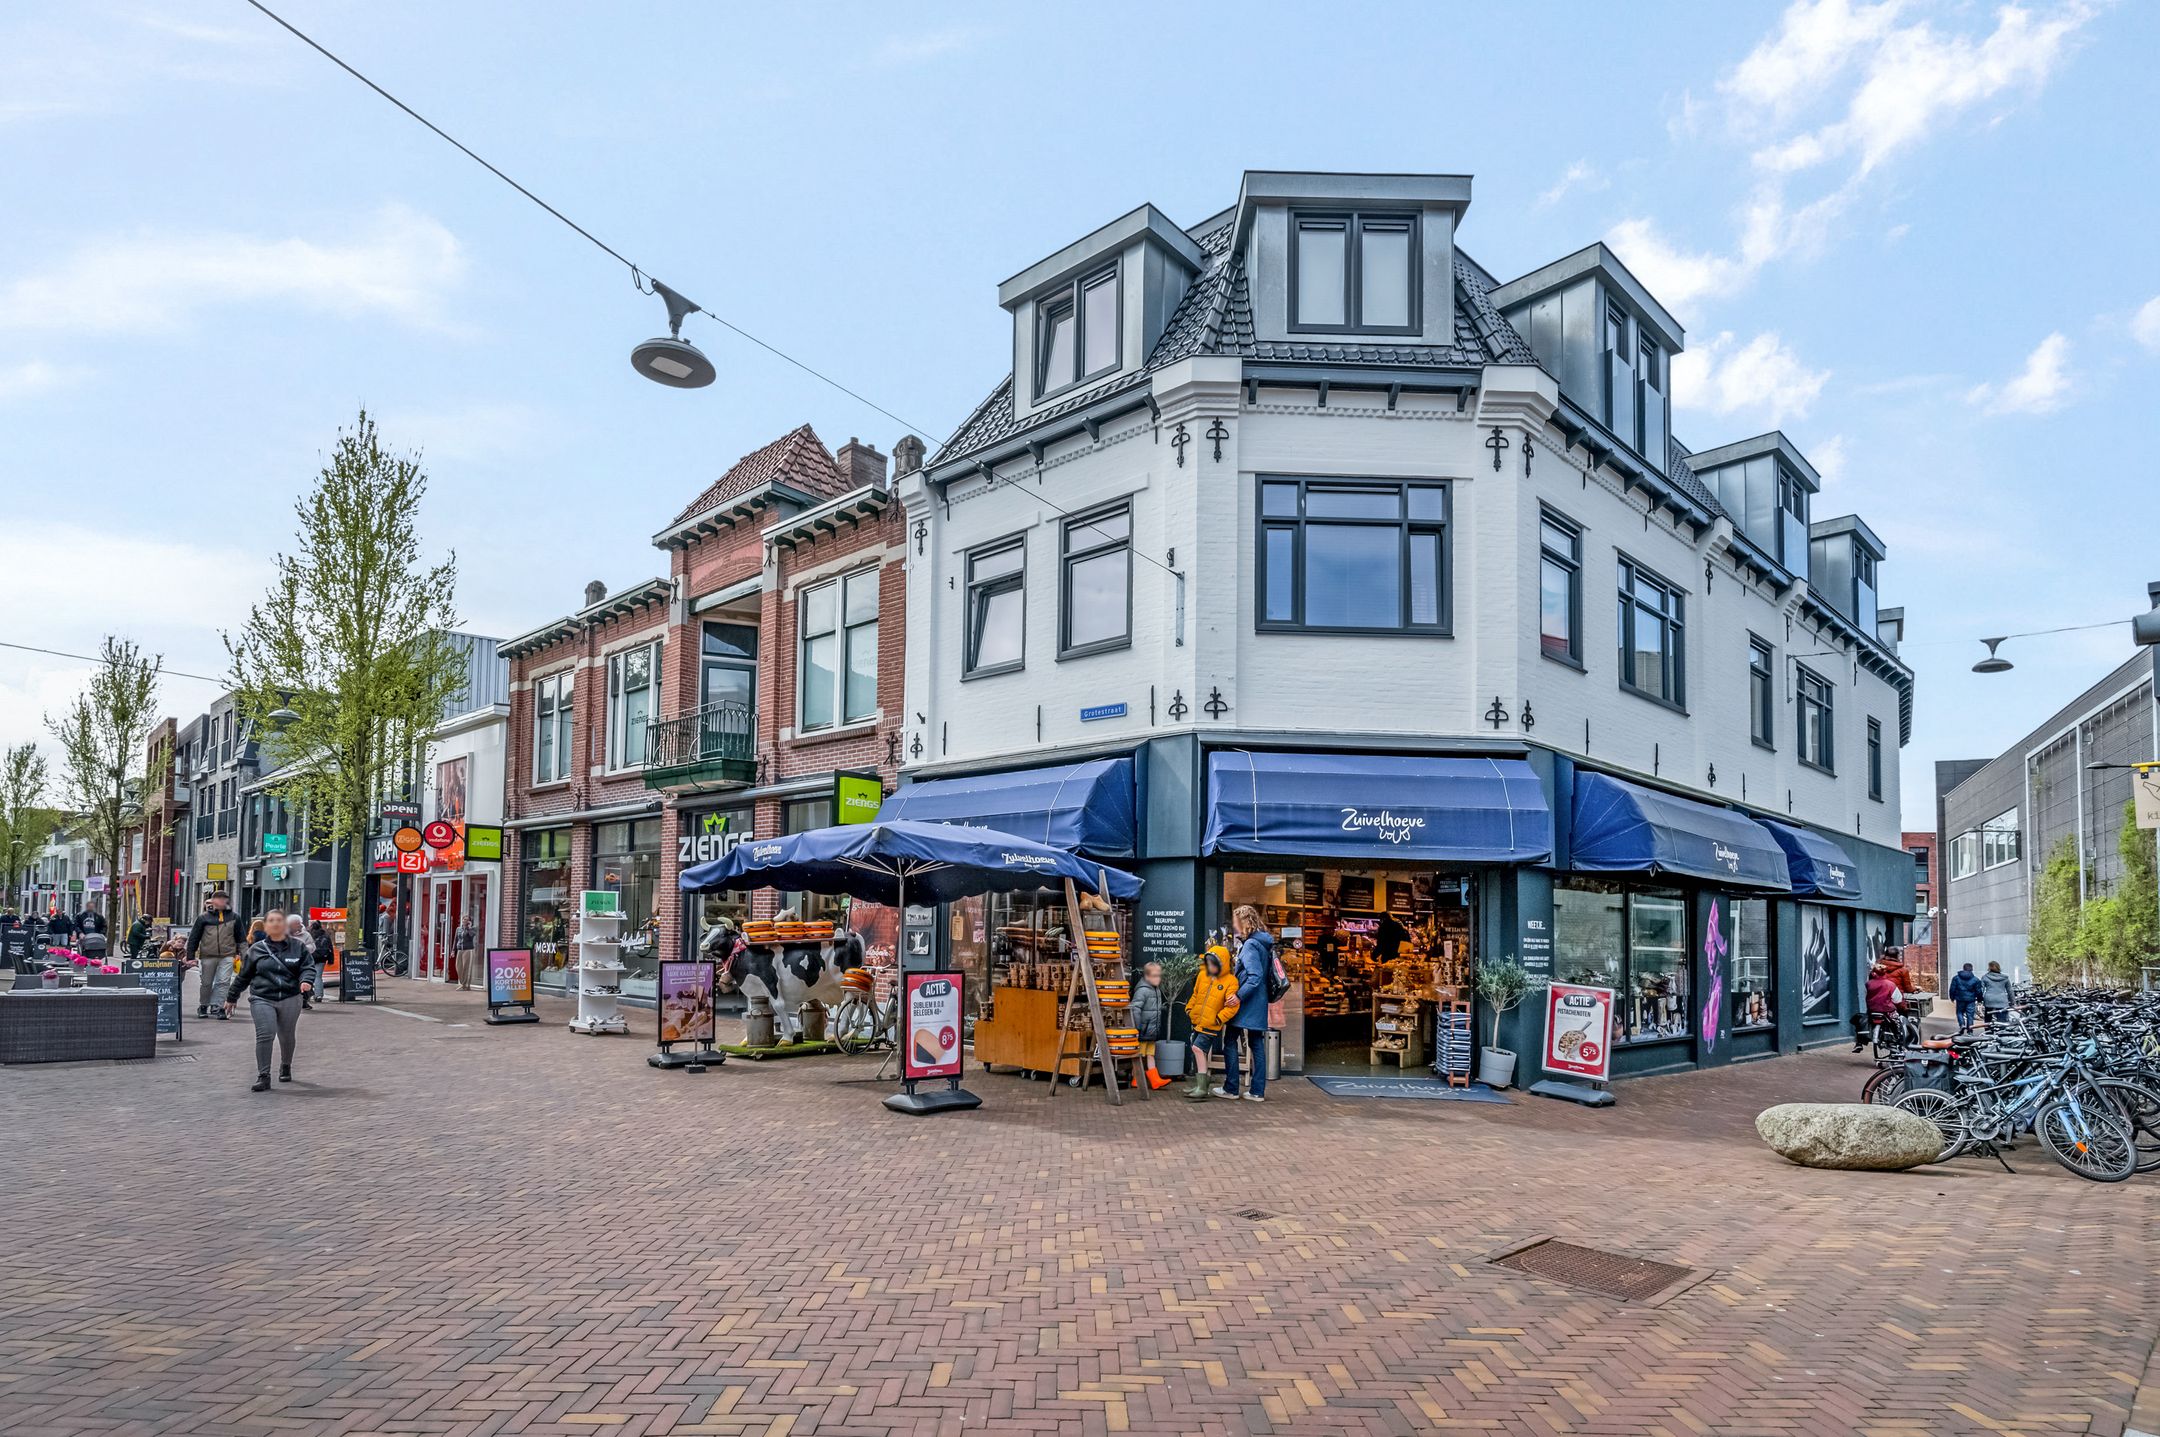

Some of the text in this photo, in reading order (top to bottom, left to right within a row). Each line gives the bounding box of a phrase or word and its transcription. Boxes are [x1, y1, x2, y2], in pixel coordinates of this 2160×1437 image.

[1083, 706, 1121, 718] Grotestraat
[845, 797, 880, 809] ZIENGS
[1341, 808, 1426, 831] Zuivelhoeve
[320, 910, 341, 919] ziggo
[495, 966, 527, 979] 20%
[925, 982, 946, 996] ACTIE
[913, 1001, 933, 1009] SUBLIEM
[1569, 995, 1591, 1006] ACTIE
[913, 1008, 933, 1017] BELEGEN
[1557, 1007, 1591, 1018] PISTACHENOTEN
